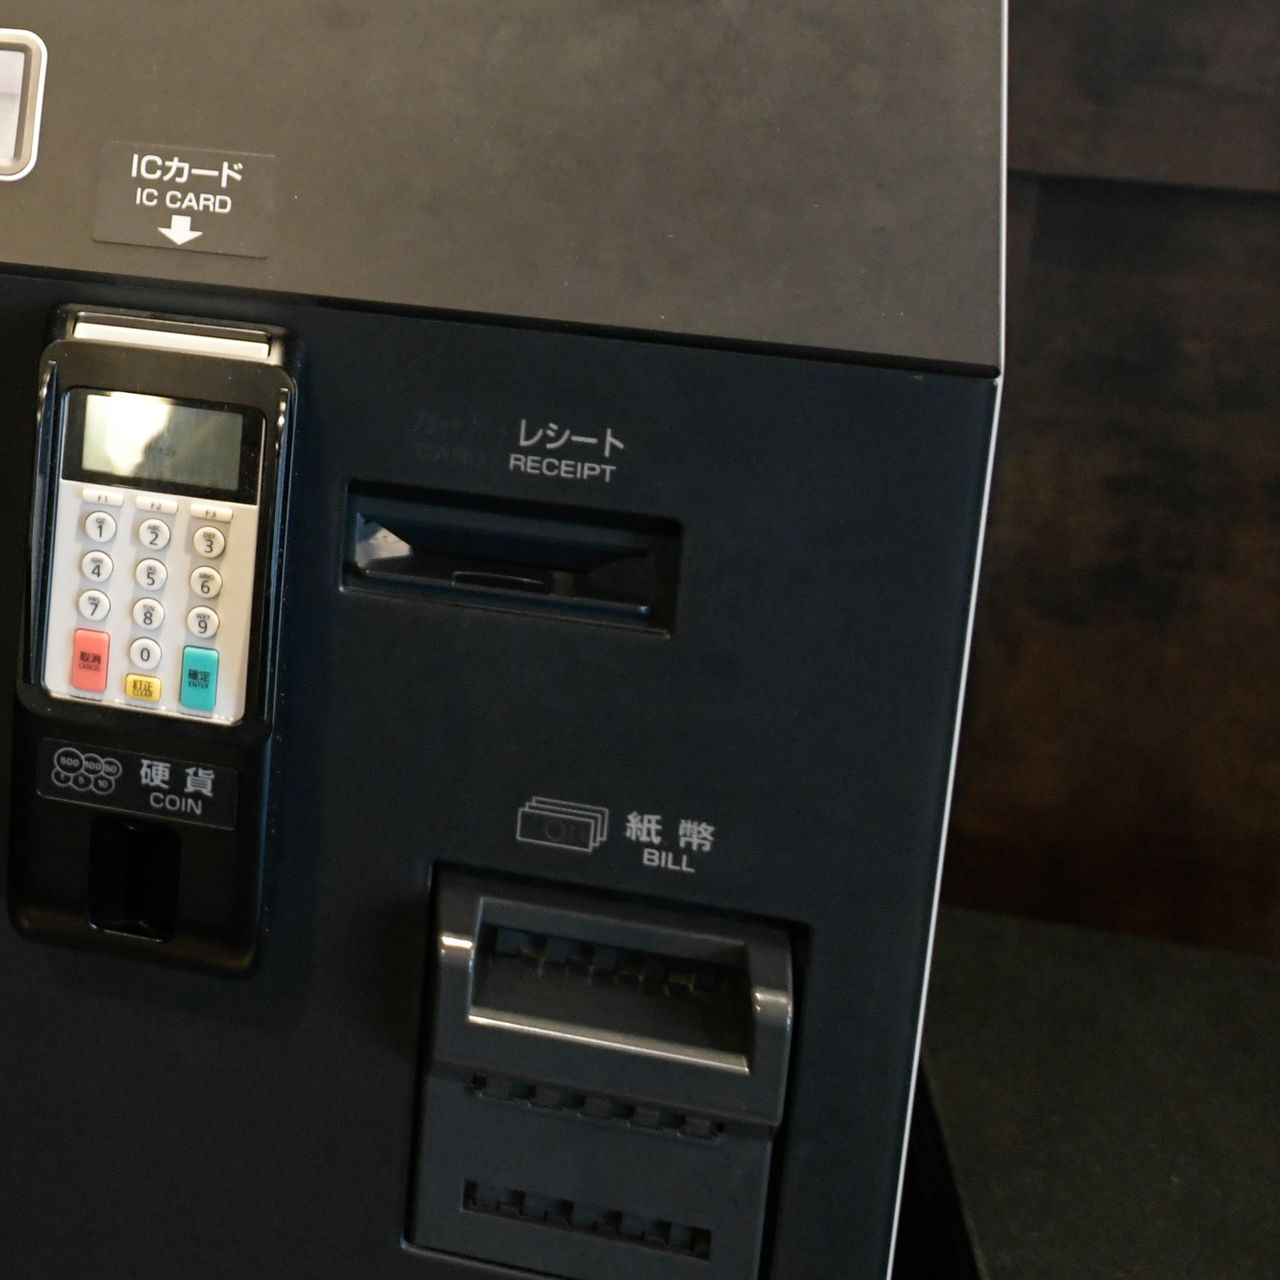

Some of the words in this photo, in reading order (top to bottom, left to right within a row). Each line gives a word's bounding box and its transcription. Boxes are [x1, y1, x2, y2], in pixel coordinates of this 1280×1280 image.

[131, 153, 244, 189] ICカード
[135, 187, 159, 207] IC
[165, 190, 232, 214] CARD
[518, 419, 625, 458] レシート
[509, 453, 617, 484] RECEIPT
[97, 524, 103, 538] 1
[149, 531, 158, 546] 2
[204, 539, 213, 554] 3
[91, 564, 102, 578] 4
[146, 572, 155, 586] 5
[201, 580, 210, 594] 6
[89, 602, 100, 617] 7
[143, 611, 153, 626] 8
[198, 619, 208, 634] 9
[140, 647, 151, 662] 0
[60, 757, 80, 767] 500
[140, 758, 215, 797] 硬貨
[149, 792, 202, 815] COIN
[625, 811, 715, 852] 紙幣
[642, 847, 695, 873] BILL
